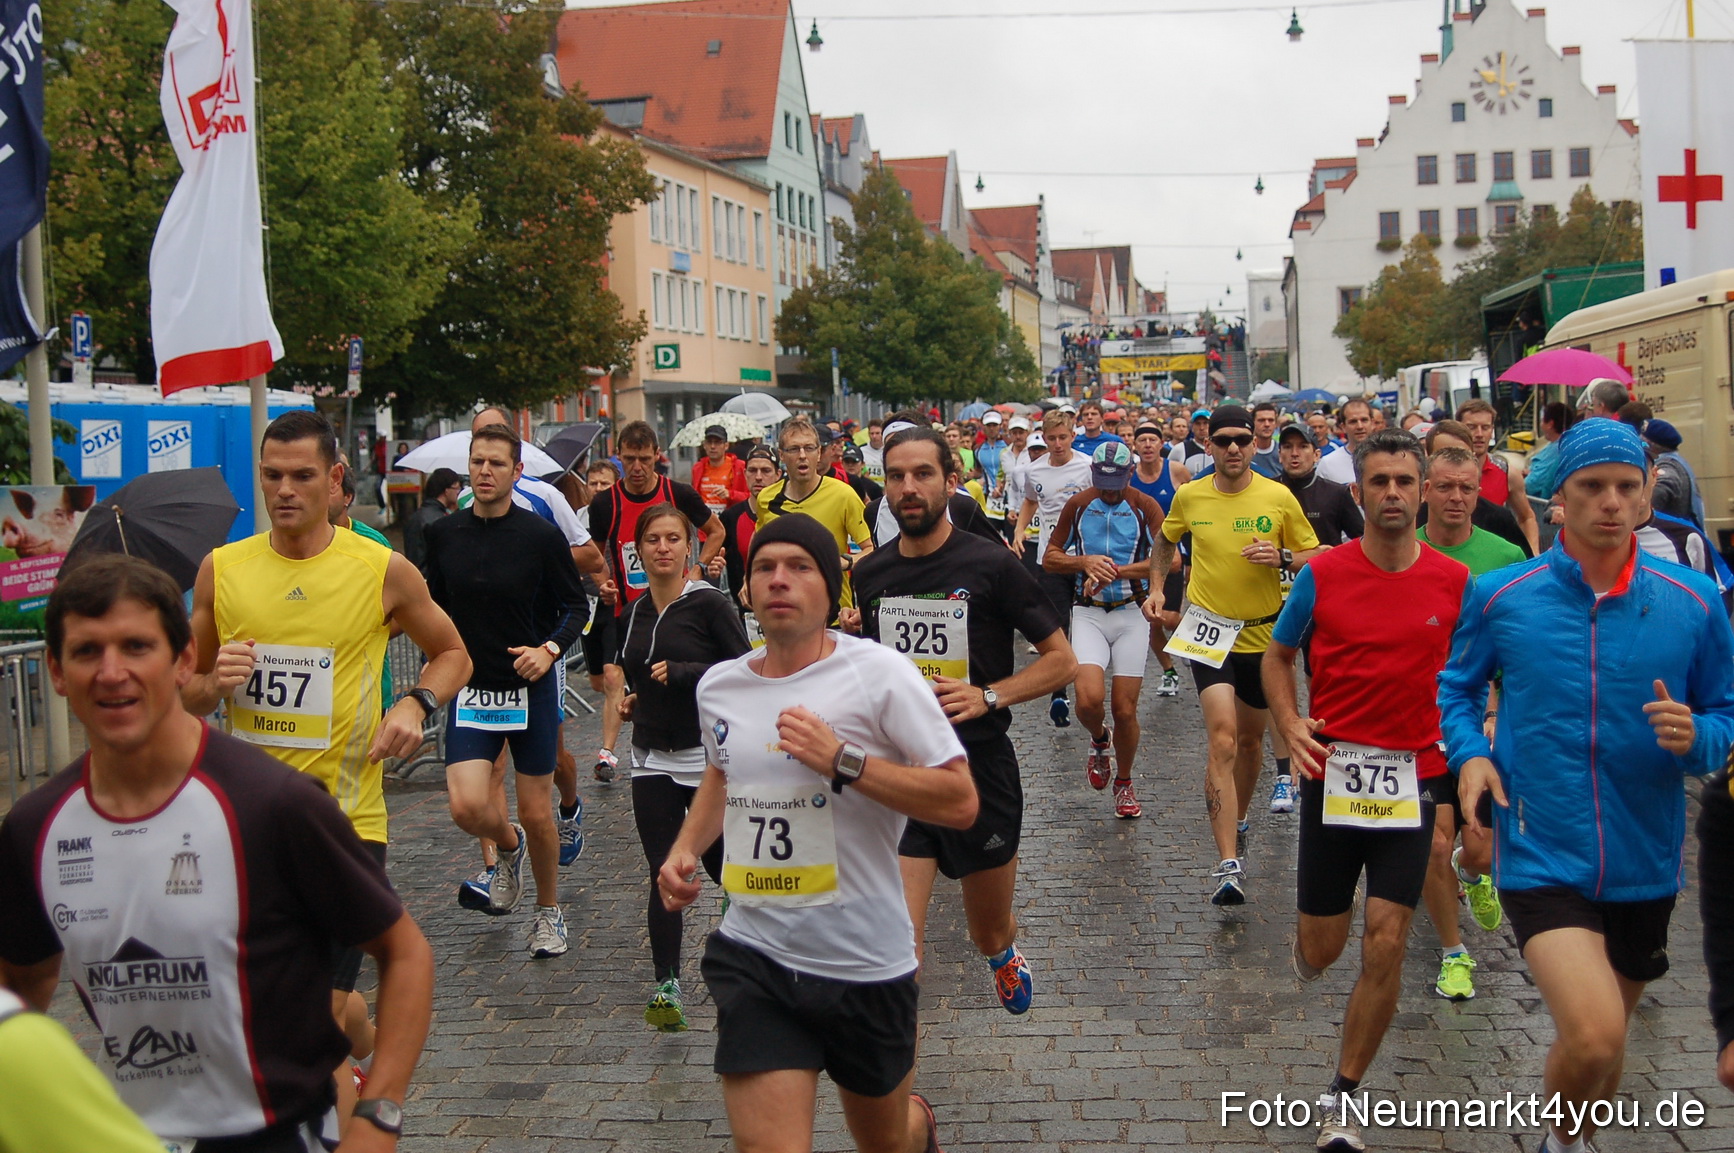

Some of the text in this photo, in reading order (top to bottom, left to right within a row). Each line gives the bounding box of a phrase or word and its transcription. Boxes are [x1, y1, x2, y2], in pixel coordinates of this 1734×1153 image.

[76, 320, 88, 353] P
[1638, 331, 1697, 361] Bayerisches
[657, 346, 677, 366] D
[1134, 358, 1170, 368] START
[1638, 364, 1665, 387] Rotes
[82, 425, 120, 454] DIXI
[149, 426, 190, 453] DIXI
[1236, 520, 1256, 529] BIKE
[2, 572, 30, 587] BEIDE
[881, 607, 906, 617] PARTL
[908, 608, 949, 618] Neumarkt
[895, 621, 949, 656] 325
[1193, 622, 1220, 646] 99
[1184, 645, 1209, 656] Stefan
[263, 654, 315, 667] Neumarkt
[245, 669, 312, 709] 457
[254, 715, 297, 733] Marco
[473, 712, 510, 722] Andreas
[1331, 749, 1401, 762] PARTL Neumarkt
[1344, 762, 1400, 796] 375
[752, 797, 806, 810] Neumarkt
[1349, 801, 1393, 816] Markus
[57, 837, 93, 851] FRANK
[749, 816, 793, 861] 73
[746, 872, 800, 890] Gunder
[165, 887, 203, 896] CATERING
